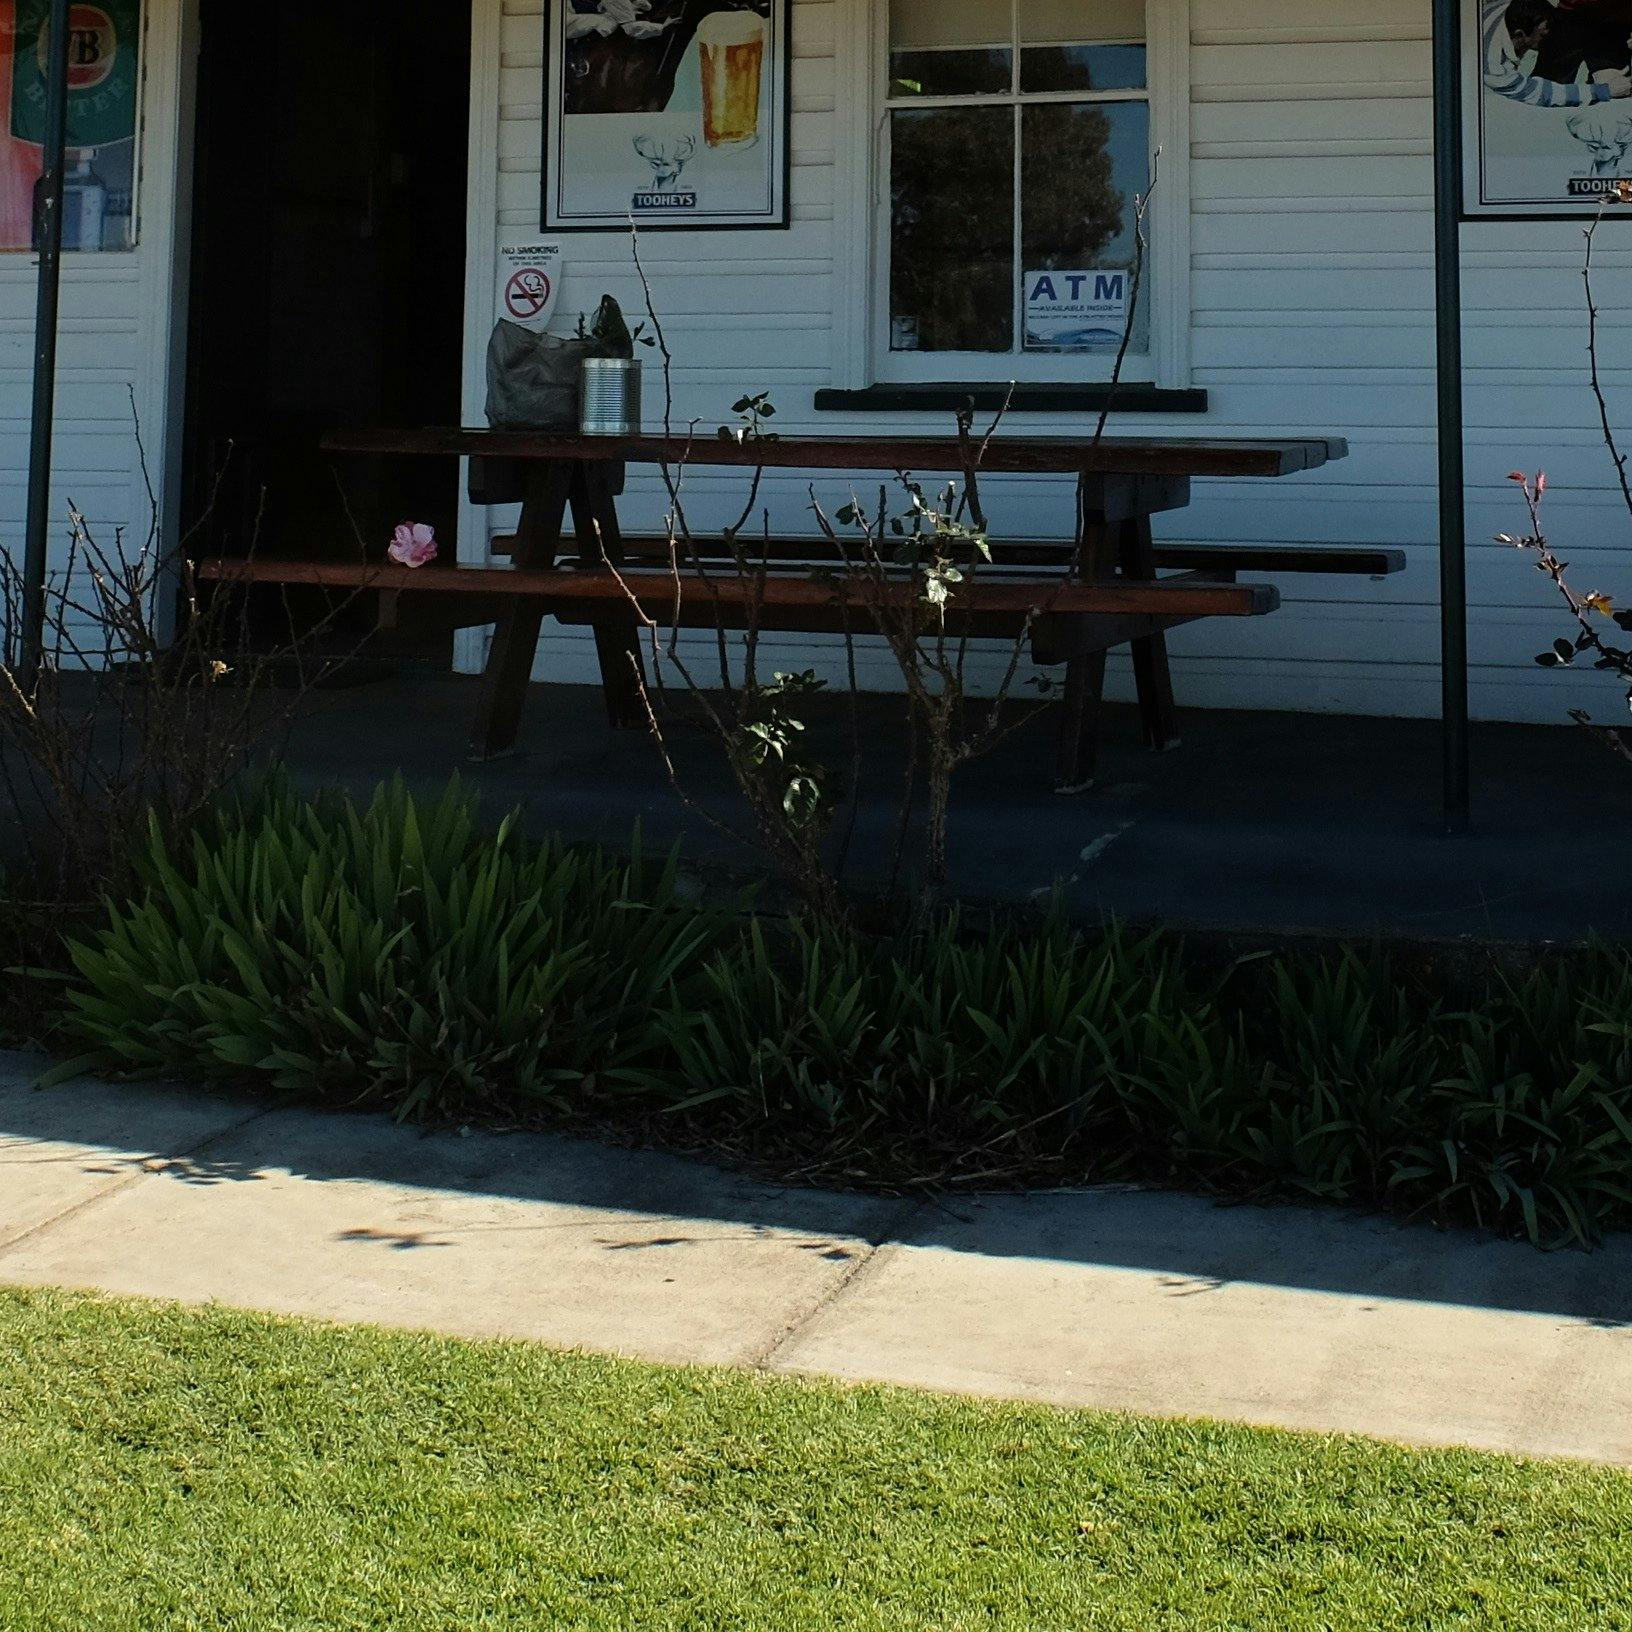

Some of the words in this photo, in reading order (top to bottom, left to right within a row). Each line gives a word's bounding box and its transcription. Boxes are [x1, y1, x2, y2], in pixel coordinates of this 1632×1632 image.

[636, 194, 694, 207] TOOHEYS
[501, 246, 515, 255] NO
[517, 245, 559, 255] SMOKING
[1028, 274, 1123, 301] ATM
[1038, 304, 1085, 312] AVAILABLE
